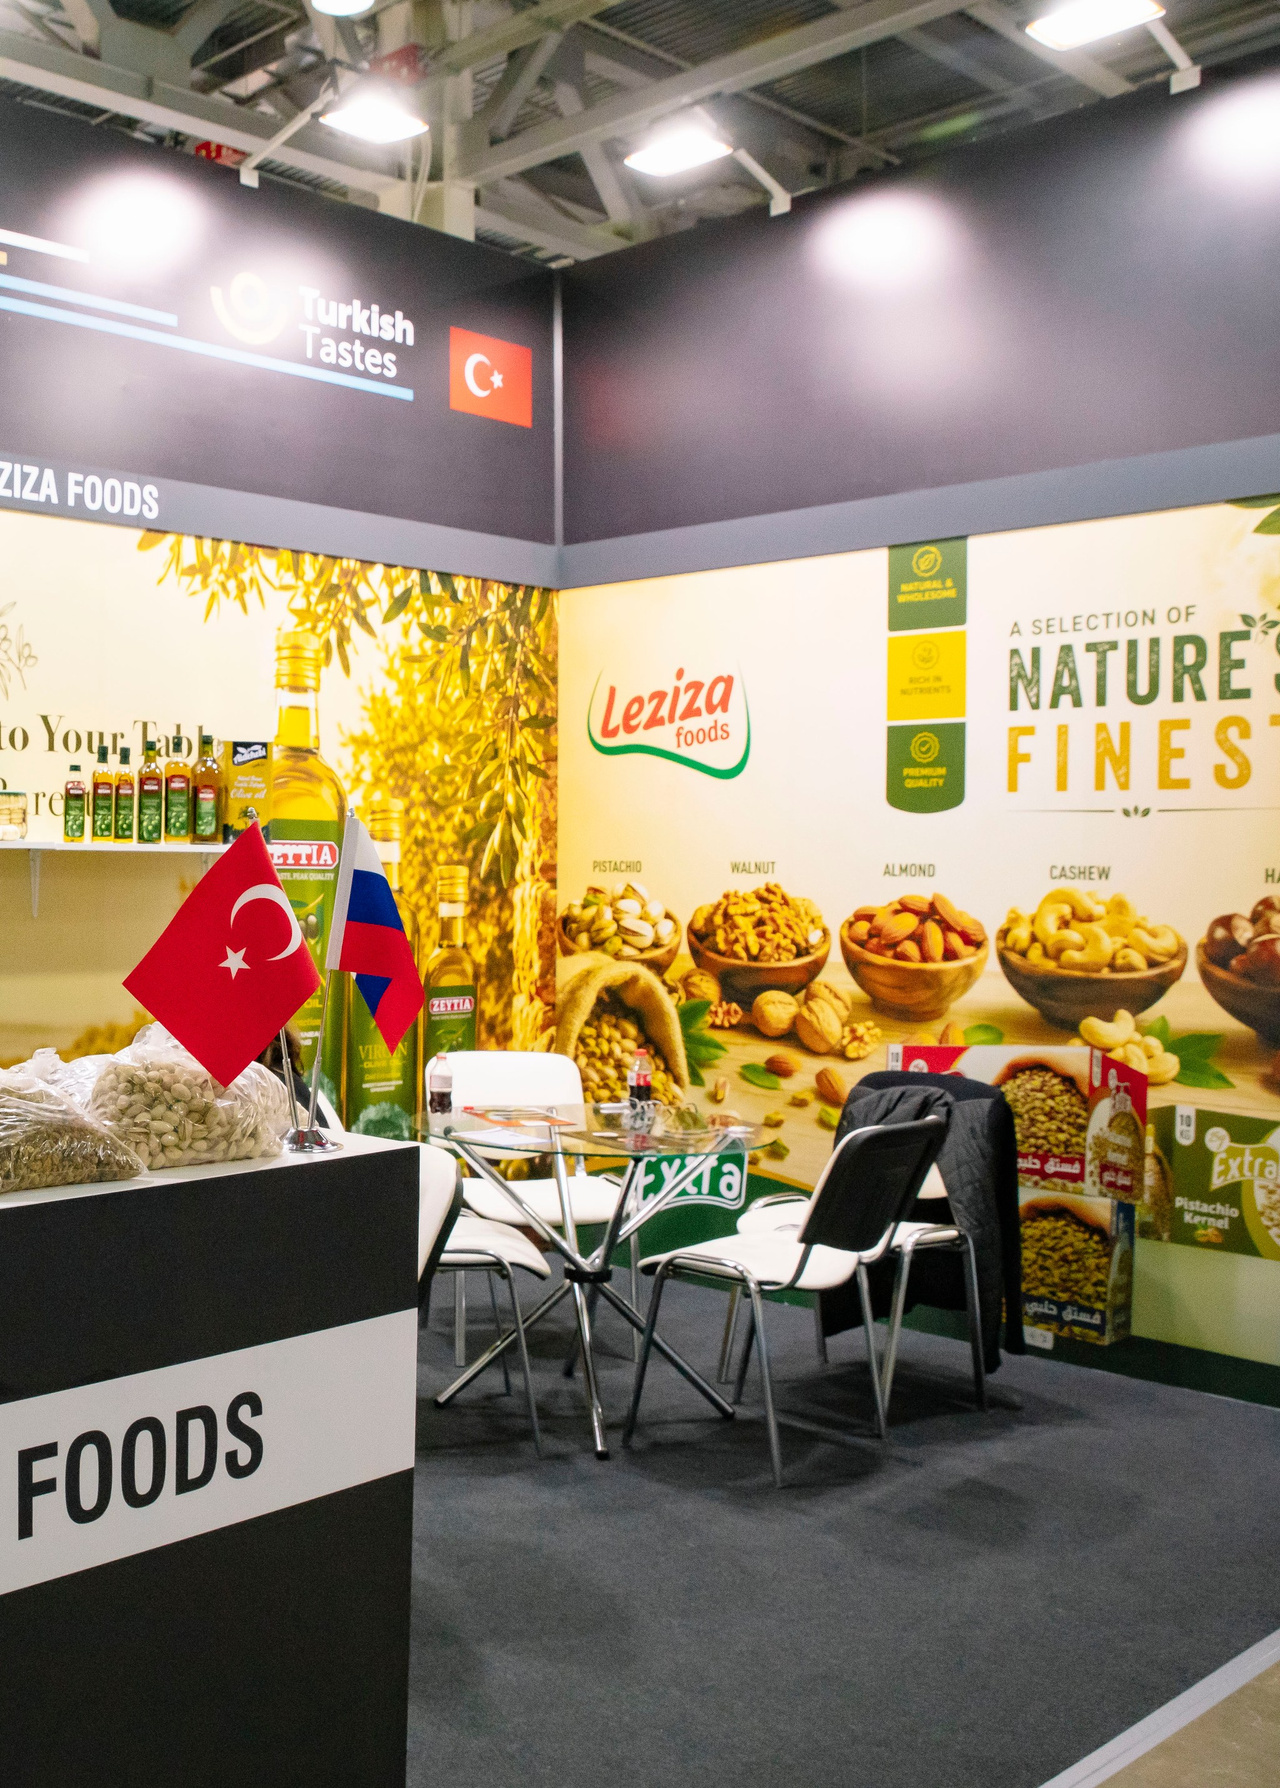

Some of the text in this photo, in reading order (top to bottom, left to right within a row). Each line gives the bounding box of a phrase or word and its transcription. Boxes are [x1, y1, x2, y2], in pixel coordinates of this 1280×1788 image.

[298, 285, 415, 346] Turkish
[298, 322, 398, 378] Tastes
[67, 472, 160, 520] FOODS
[900, 579, 943, 593] NATURAL
[896, 587, 958, 603] WHOLESOME
[1010, 604, 1197, 638] A SELECTION OF
[908, 675, 942, 686] RICH IN
[900, 685, 952, 696] NUTRIENTS
[601, 667, 734, 739] Leziza
[36, 713, 125, 756] Your
[675, 719, 731, 749] foods
[903, 767, 947, 777] PREMIUM
[904, 777, 945, 788] QUALITY
[592, 860, 642, 874] PISTACHIO
[730, 861, 776, 874] WALNUT
[883, 863, 936, 878] ALMOND
[1049, 865, 1112, 881] CASHEW
[432, 998, 471, 1012] ZEYTIA
[1179, 1114, 1192, 1127] 10
[1211, 1147, 1278, 1187] Extra
[1175, 1196, 1240, 1218] Pistachio
[1184, 1211, 1230, 1230] Kernel
[18, 1391, 264, 1541] FOODS
